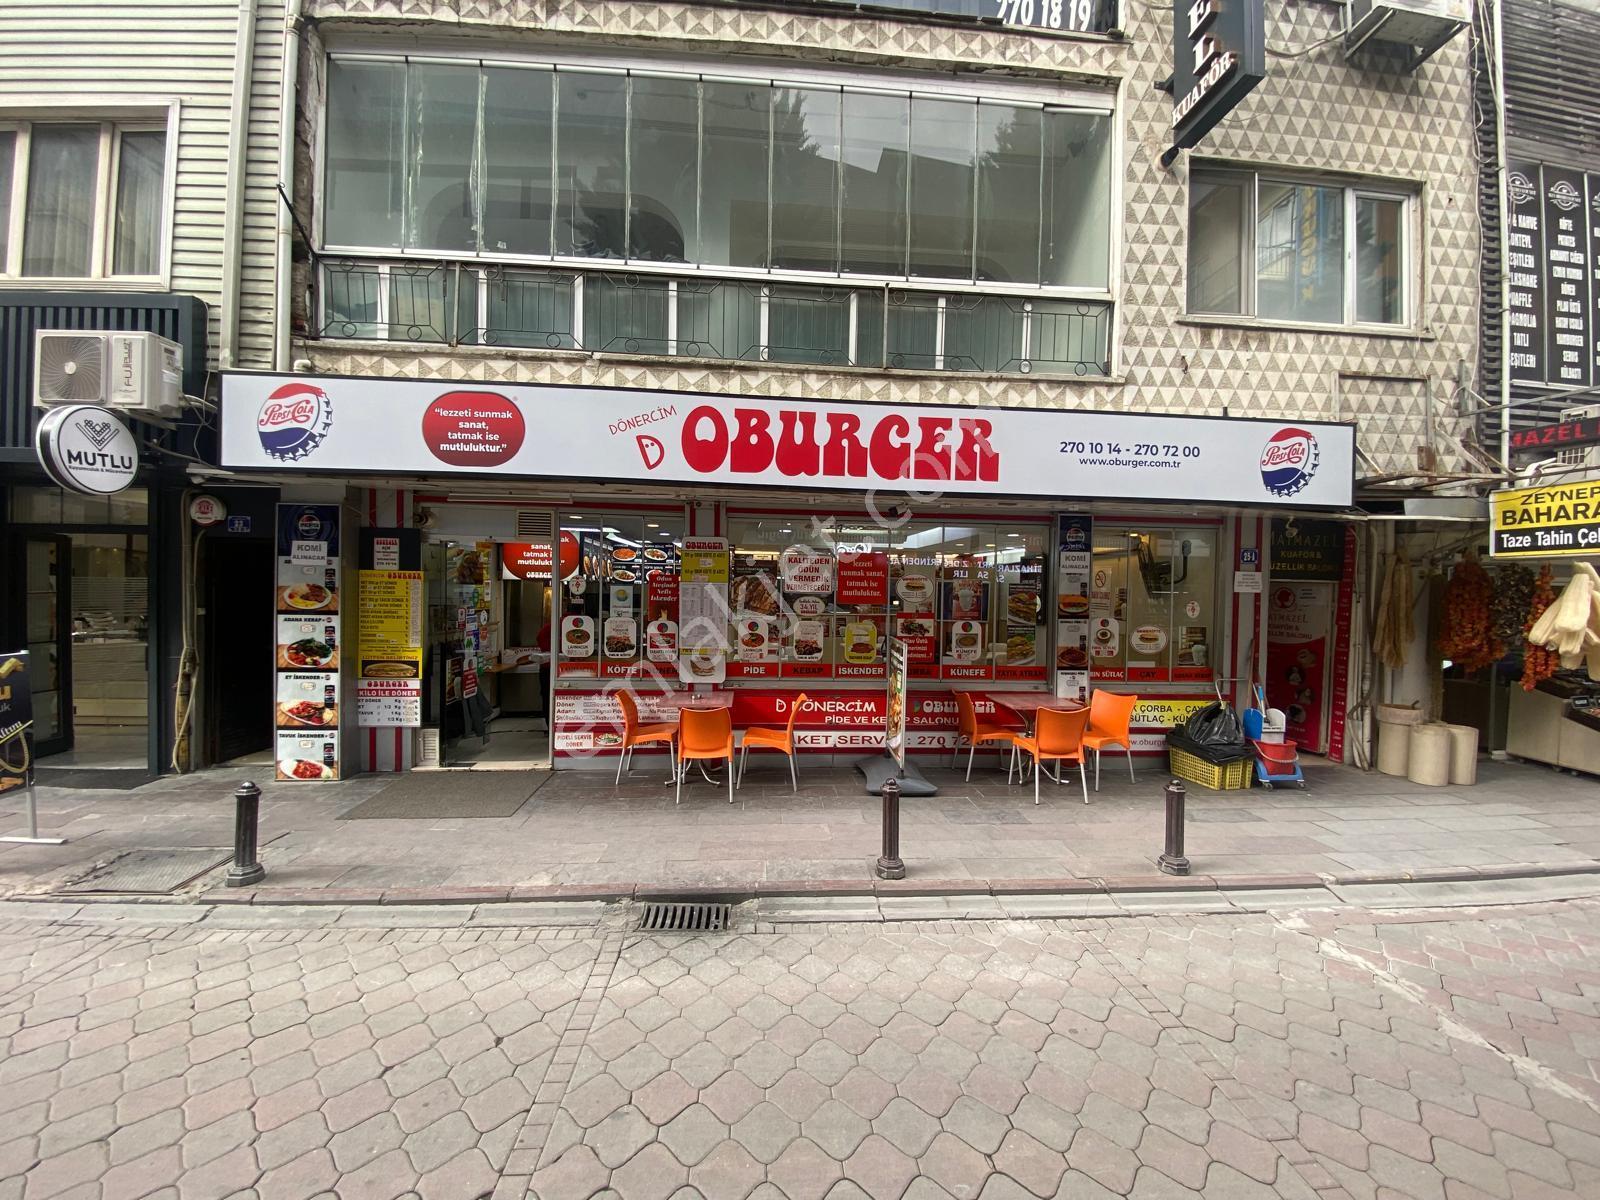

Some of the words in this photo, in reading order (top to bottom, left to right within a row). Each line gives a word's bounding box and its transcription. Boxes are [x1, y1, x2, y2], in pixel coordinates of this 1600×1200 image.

[1041, 0, 1062, 29] 18
[1070, 0, 1091, 32] 19
[474, 410, 513, 419] sunmak
[458, 420, 489, 430] sanat,
[608, 405, 678, 435] DÖNERCİM
[447, 431, 483, 440] tatmak
[485, 432, 499, 440] ise
[681, 405, 999, 482] OBURGER
[1060, 441, 1085, 453] 270
[1089, 442, 1103, 454] 10
[1106, 443, 1122, 455] 14
[1134, 444, 1159, 456] 270
[1163, 445, 1179, 457] 72
[1182, 446, 1200, 458] 00
[67, 449, 133, 469] MUTLU
[1079, 457, 1181, 469] www.oburger.com.tr
[1501, 533, 1532, 549] Taze
[1535, 527, 1573, 547] Tahin
[297, 544, 322, 552] KOMİ
[1065, 554, 1086, 562] KOMİ
[607, 665, 638, 674] KÖFTE
[743, 665, 766, 674] PİDE
[950, 667, 986, 677] KÜNEFE
[1101, 670, 1125, 679] SÜTLAÇ
[1140, 704, 1173, 714] ÇORBA
[825, 714, 851, 724] PİDE
[854, 716, 869, 724] VE
[913, 716, 959, 724] SALONU
[837, 735, 885, 745] SERV
[917, 735, 945, 746] 270
[952, 736, 971, 746] 72
